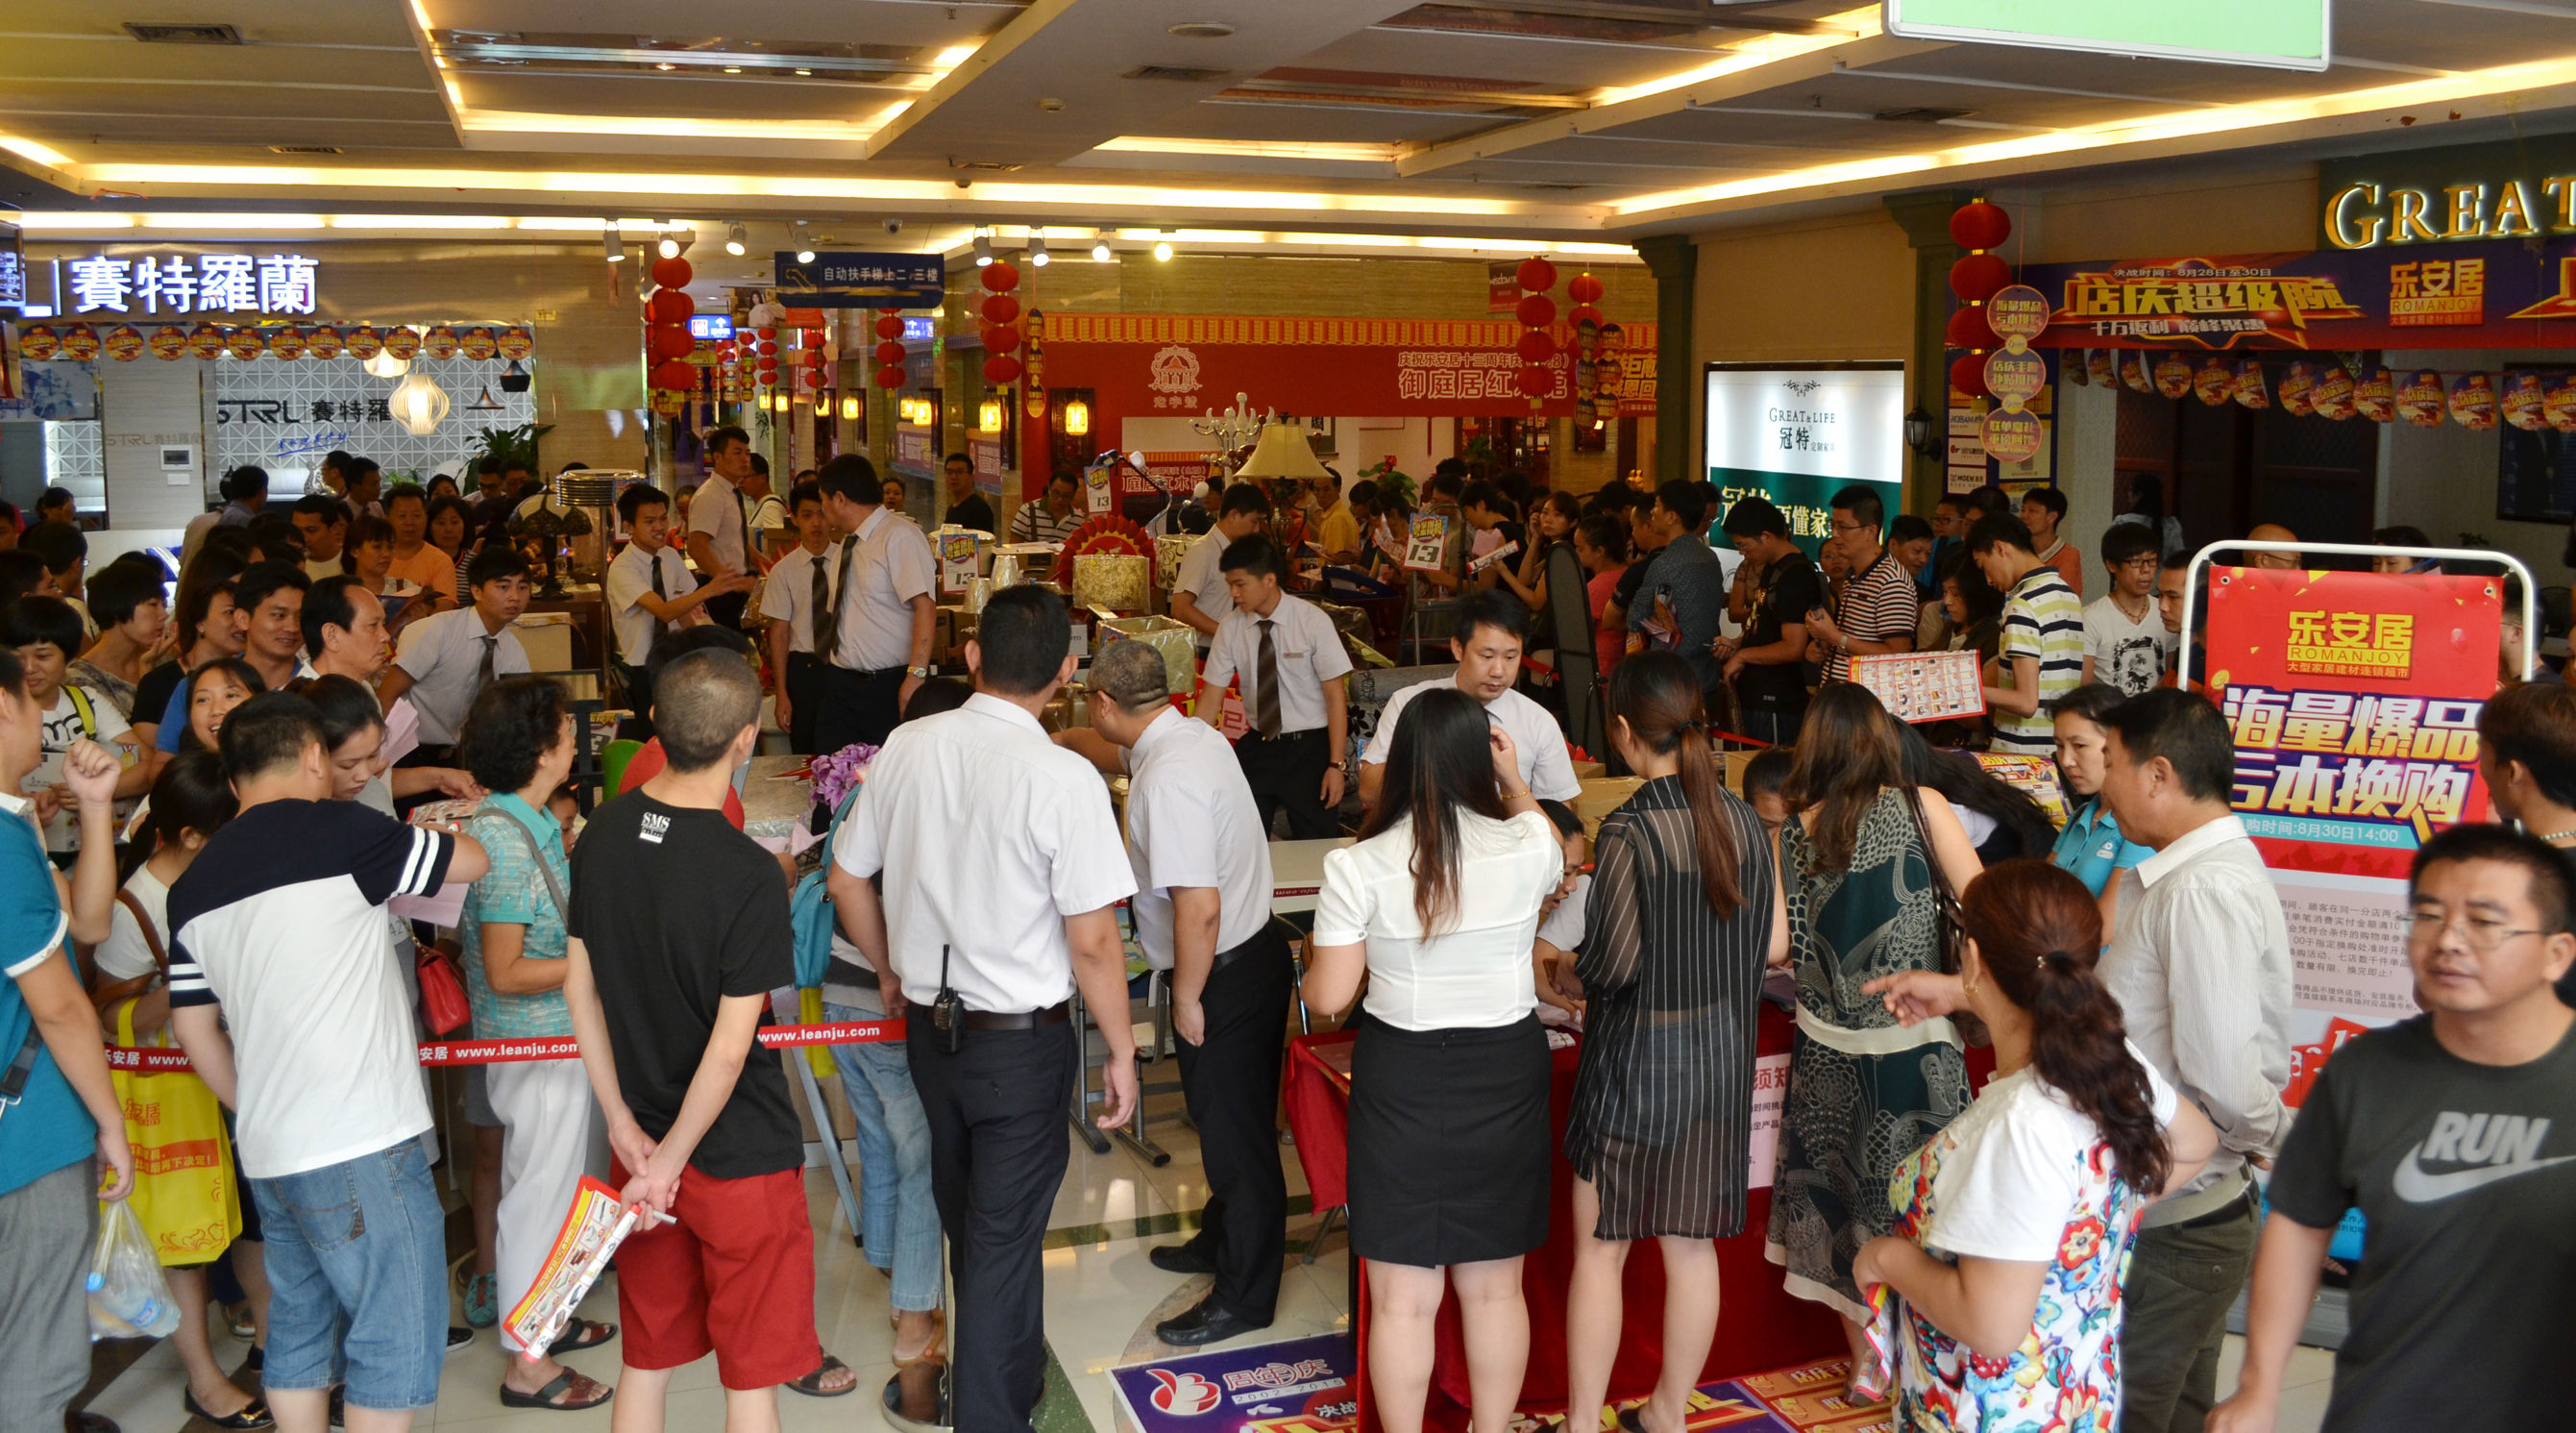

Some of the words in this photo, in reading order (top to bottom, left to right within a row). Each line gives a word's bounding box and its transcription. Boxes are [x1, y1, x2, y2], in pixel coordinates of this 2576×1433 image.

[2325, 177, 2576, 249] GREAT
[71, 255, 319, 313] 賽特羅蘭
[2390, 259, 2485, 298] 乐安居
[2392, 298, 2480, 312] ROMANJOY
[1398, 369, 1568, 400] 御庭居红馆
[1779, 426, 1810, 451] 冠特
[1408, 544, 1440, 563] 13
[2288, 610, 2415, 650] 乐安居
[2287, 662, 2409, 679] 大型家居建材连锁超市
[2291, 647, 2406, 663] ROMANJOY
[2223, 687, 2484, 761] 海量爆品
[2230, 750, 2471, 834] 亏本换购
[641, 811, 671, 829] SMS
[2244, 817, 2399, 843] 购时间:8月30日14:00
[757, 1026, 881, 1043] www.leanju.com
[2421, 1111, 2551, 1164] RUN
[1222, 1359, 1334, 1392] 周年庆
